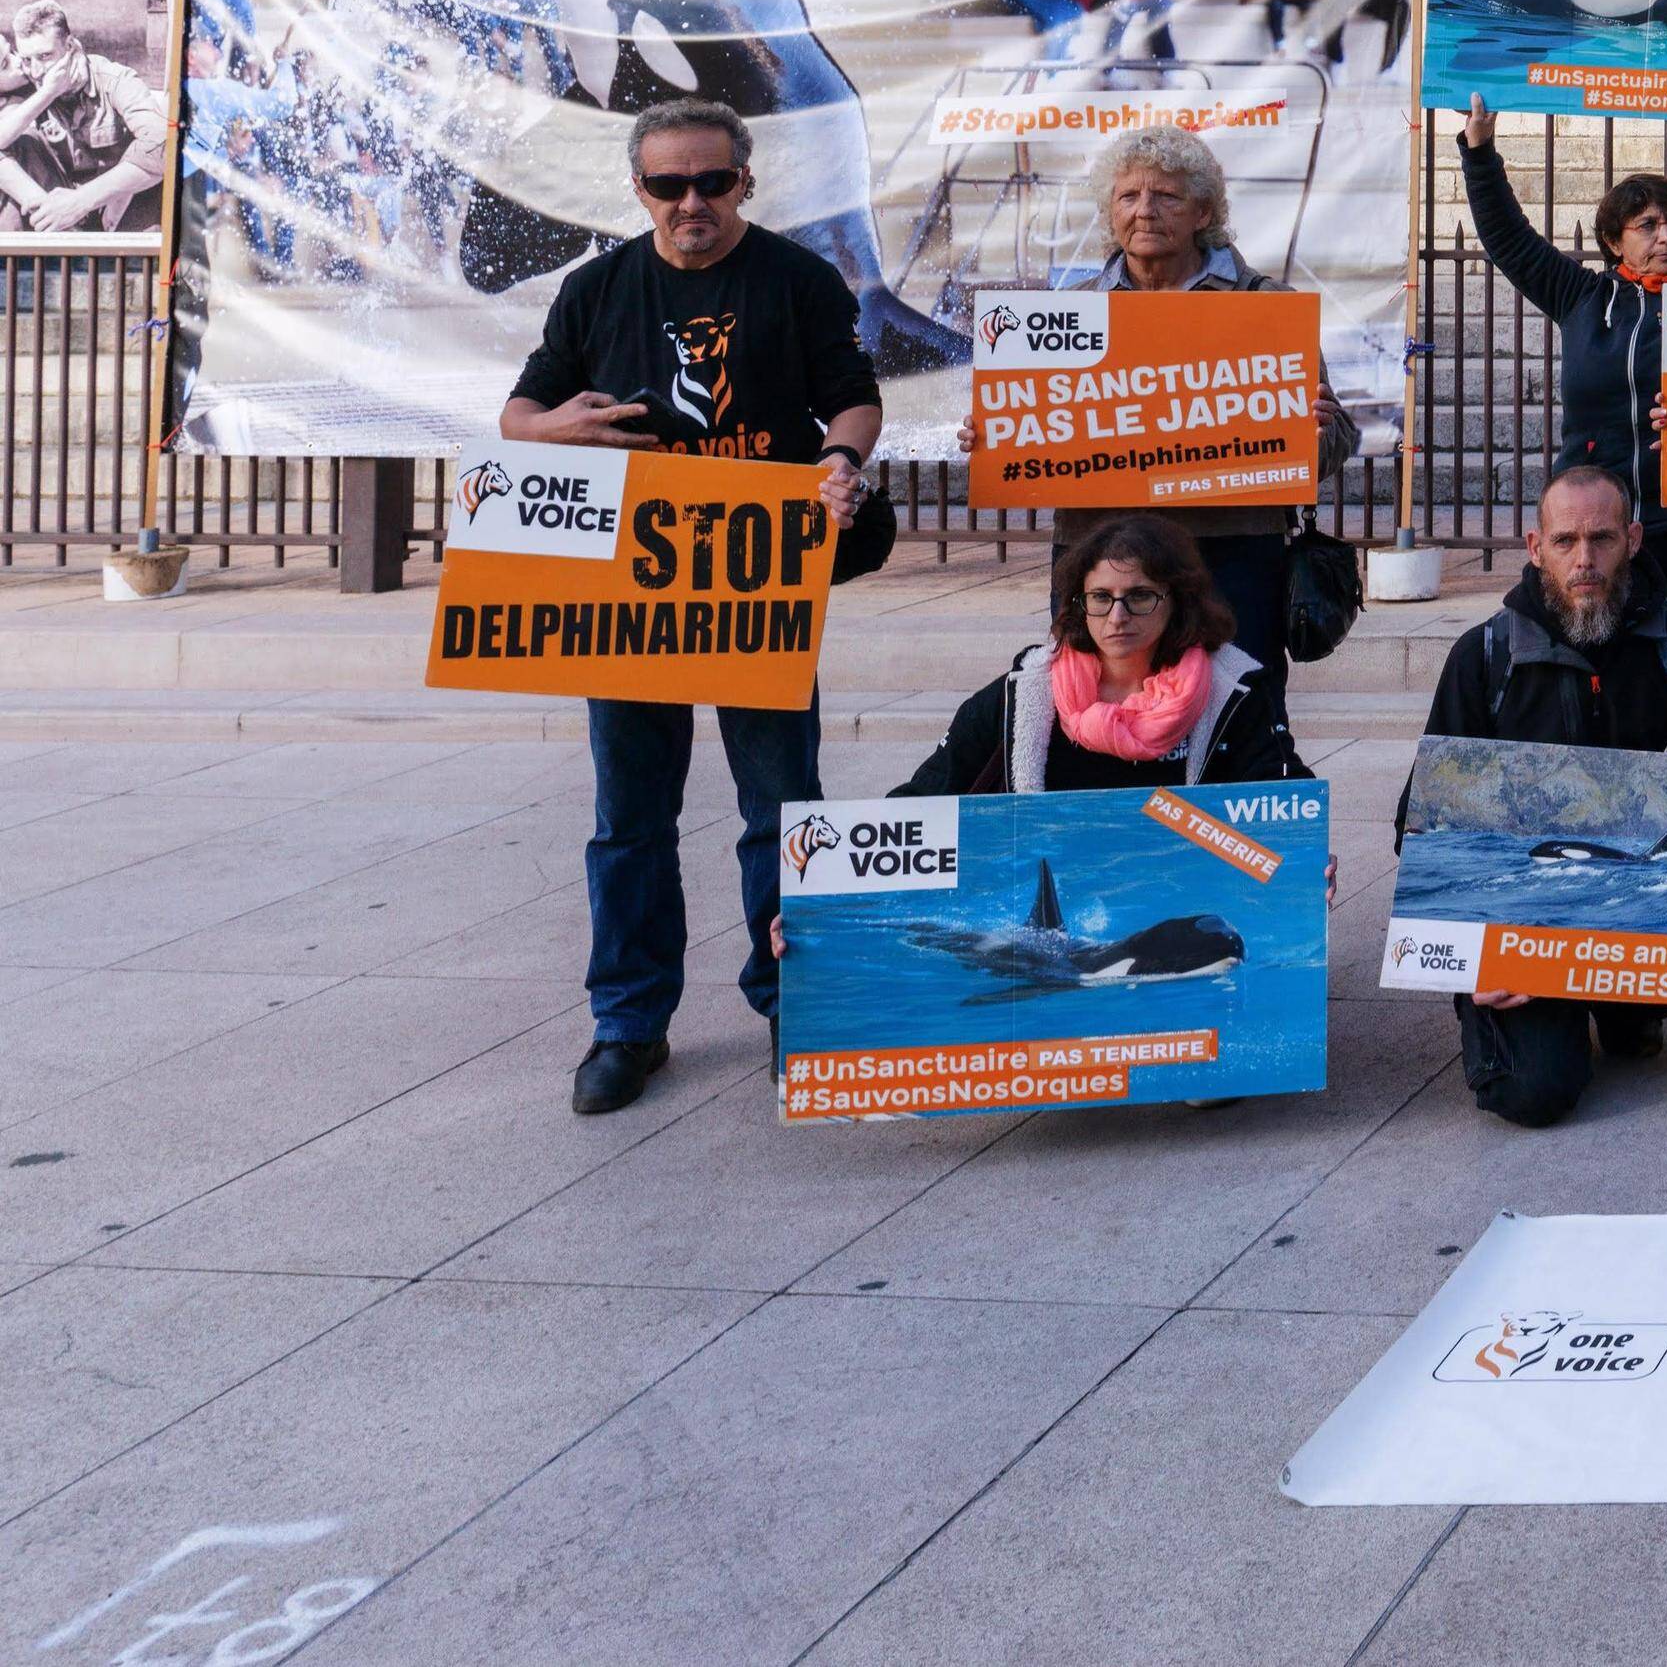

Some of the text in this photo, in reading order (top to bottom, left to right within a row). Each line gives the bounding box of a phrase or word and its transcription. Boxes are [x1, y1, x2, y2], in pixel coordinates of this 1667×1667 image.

[939, 100, 1279, 135] #StopDelphinarium
[1026, 312, 1080, 331] ONE
[1026, 332, 1104, 352] VOICE
[980, 352, 1306, 412] UN SANCTUAIRE
[985, 385, 1309, 450] PAS LE JAPON
[1002, 434, 1287, 482] #StopDelphinarium
[521, 474, 589, 503] ONE
[1153, 466, 1310, 495] ET PAS TENERIFE
[518, 501, 617, 533] VOICE
[632, 498, 827, 593] STOP
[442, 600, 813, 659] DELPHINARIUM
[1223, 794, 1321, 823] Wikie
[849, 821, 923, 848] ONE
[1150, 794, 1279, 876] PAS TENERIFE
[850, 847, 957, 877] VOICE
[1421, 943, 1454, 958] ONE
[1500, 932, 1568, 961] Pour
[1575, 935, 1626, 963] des
[1420, 956, 1467, 972] VOICE
[790, 1040, 1205, 1083] #UnSanctuaire PAS TENERIFE
[790, 1071, 1125, 1113] #SauvonsNosOrques
[1569, 1332, 1635, 1353] one
[1553, 1350, 1646, 1374] voice
